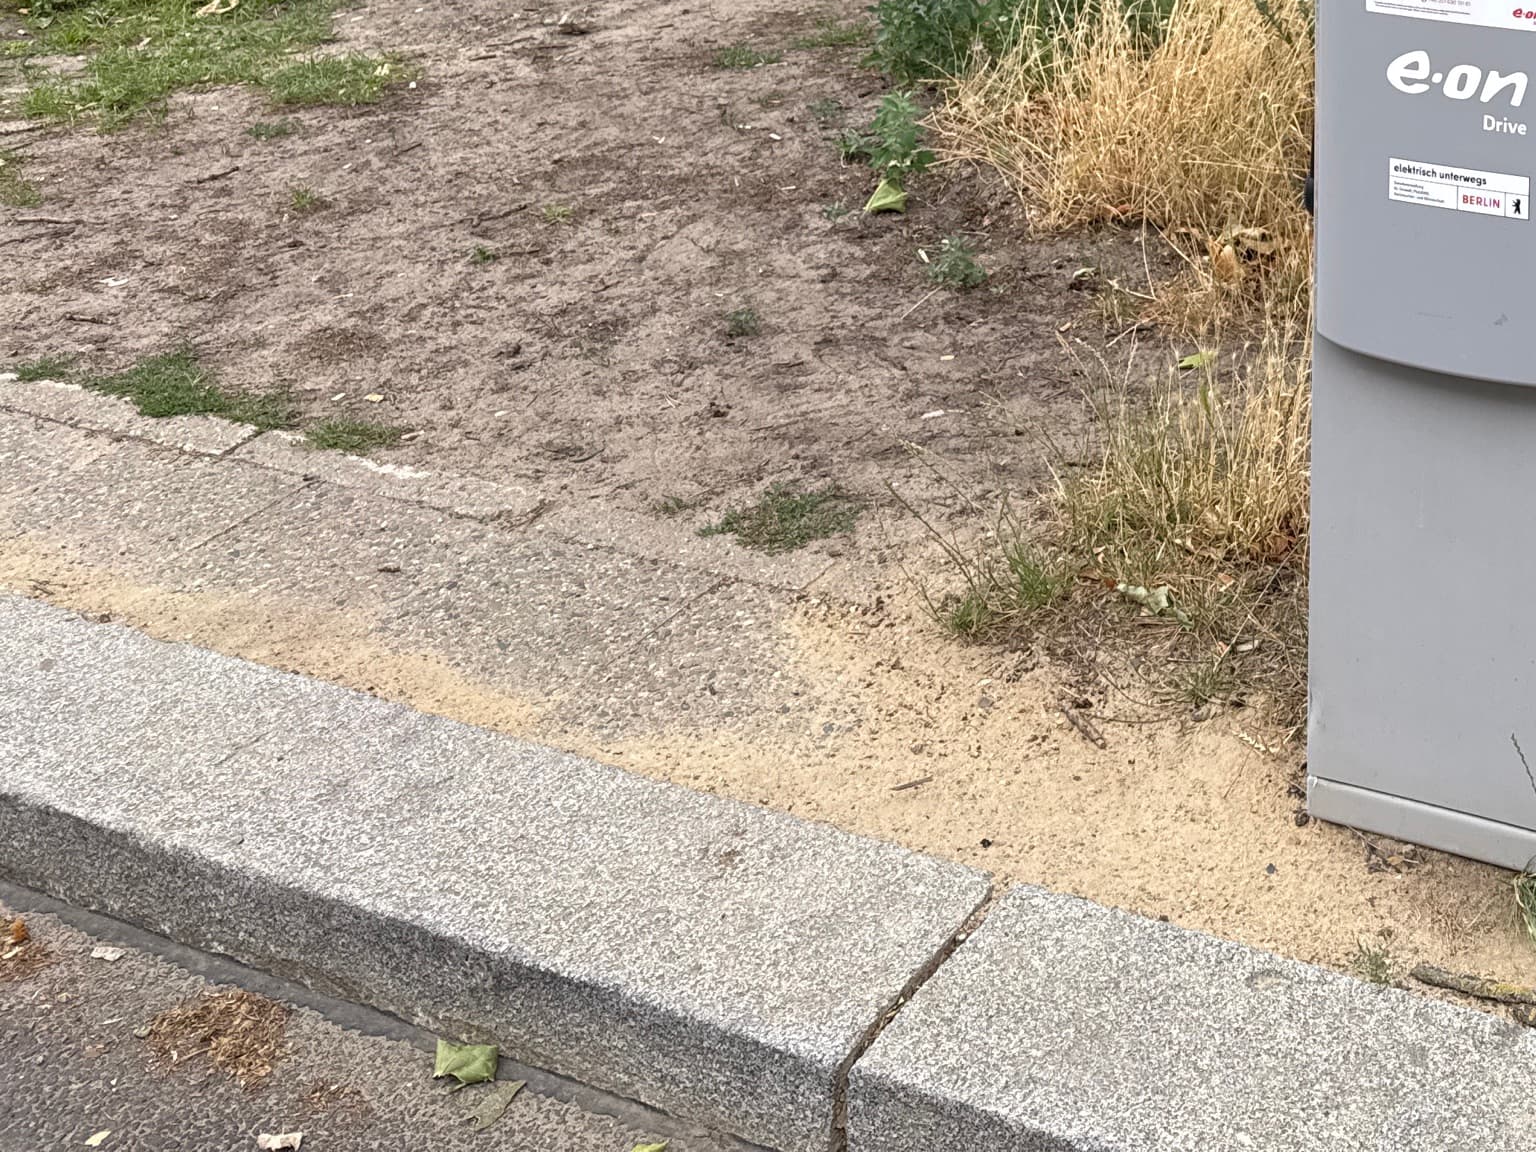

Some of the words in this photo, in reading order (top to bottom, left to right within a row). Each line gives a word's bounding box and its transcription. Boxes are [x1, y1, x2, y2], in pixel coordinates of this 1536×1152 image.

[1483, 115, 1527, 135] Drive
[1393, 164, 1437, 178] elektrisch
[1439, 171, 1487, 187] unterwegs
[1462, 194, 1501, 209] BERLIN
